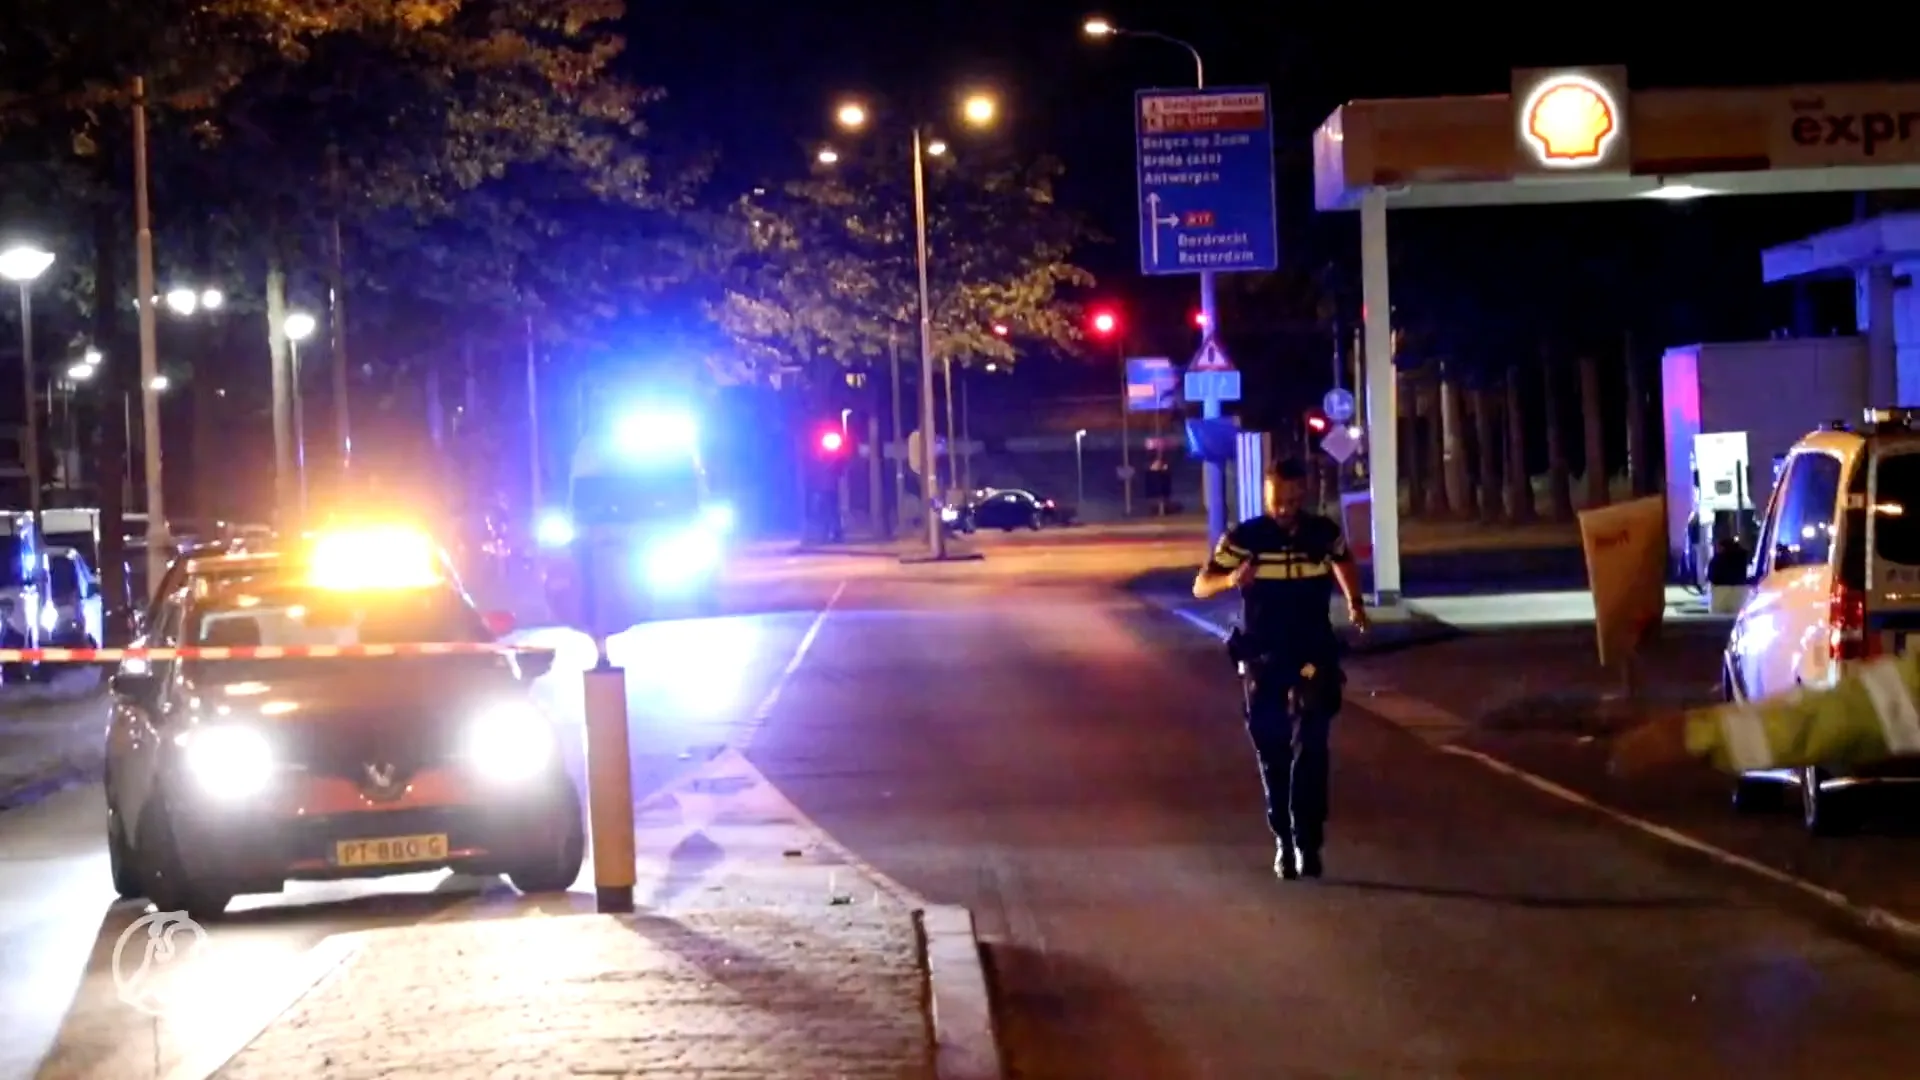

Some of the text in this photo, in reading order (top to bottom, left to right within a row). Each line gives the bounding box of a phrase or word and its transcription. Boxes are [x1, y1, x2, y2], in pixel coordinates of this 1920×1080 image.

[1143, 133, 1249, 150] Bergen op Zoom
[1143, 154, 1182, 167] Breda
[1144, 172, 1220, 185] Antwerpen
[1178, 232, 1247, 247] Dordrecht
[1179, 251, 1254, 264] Rotterdam
